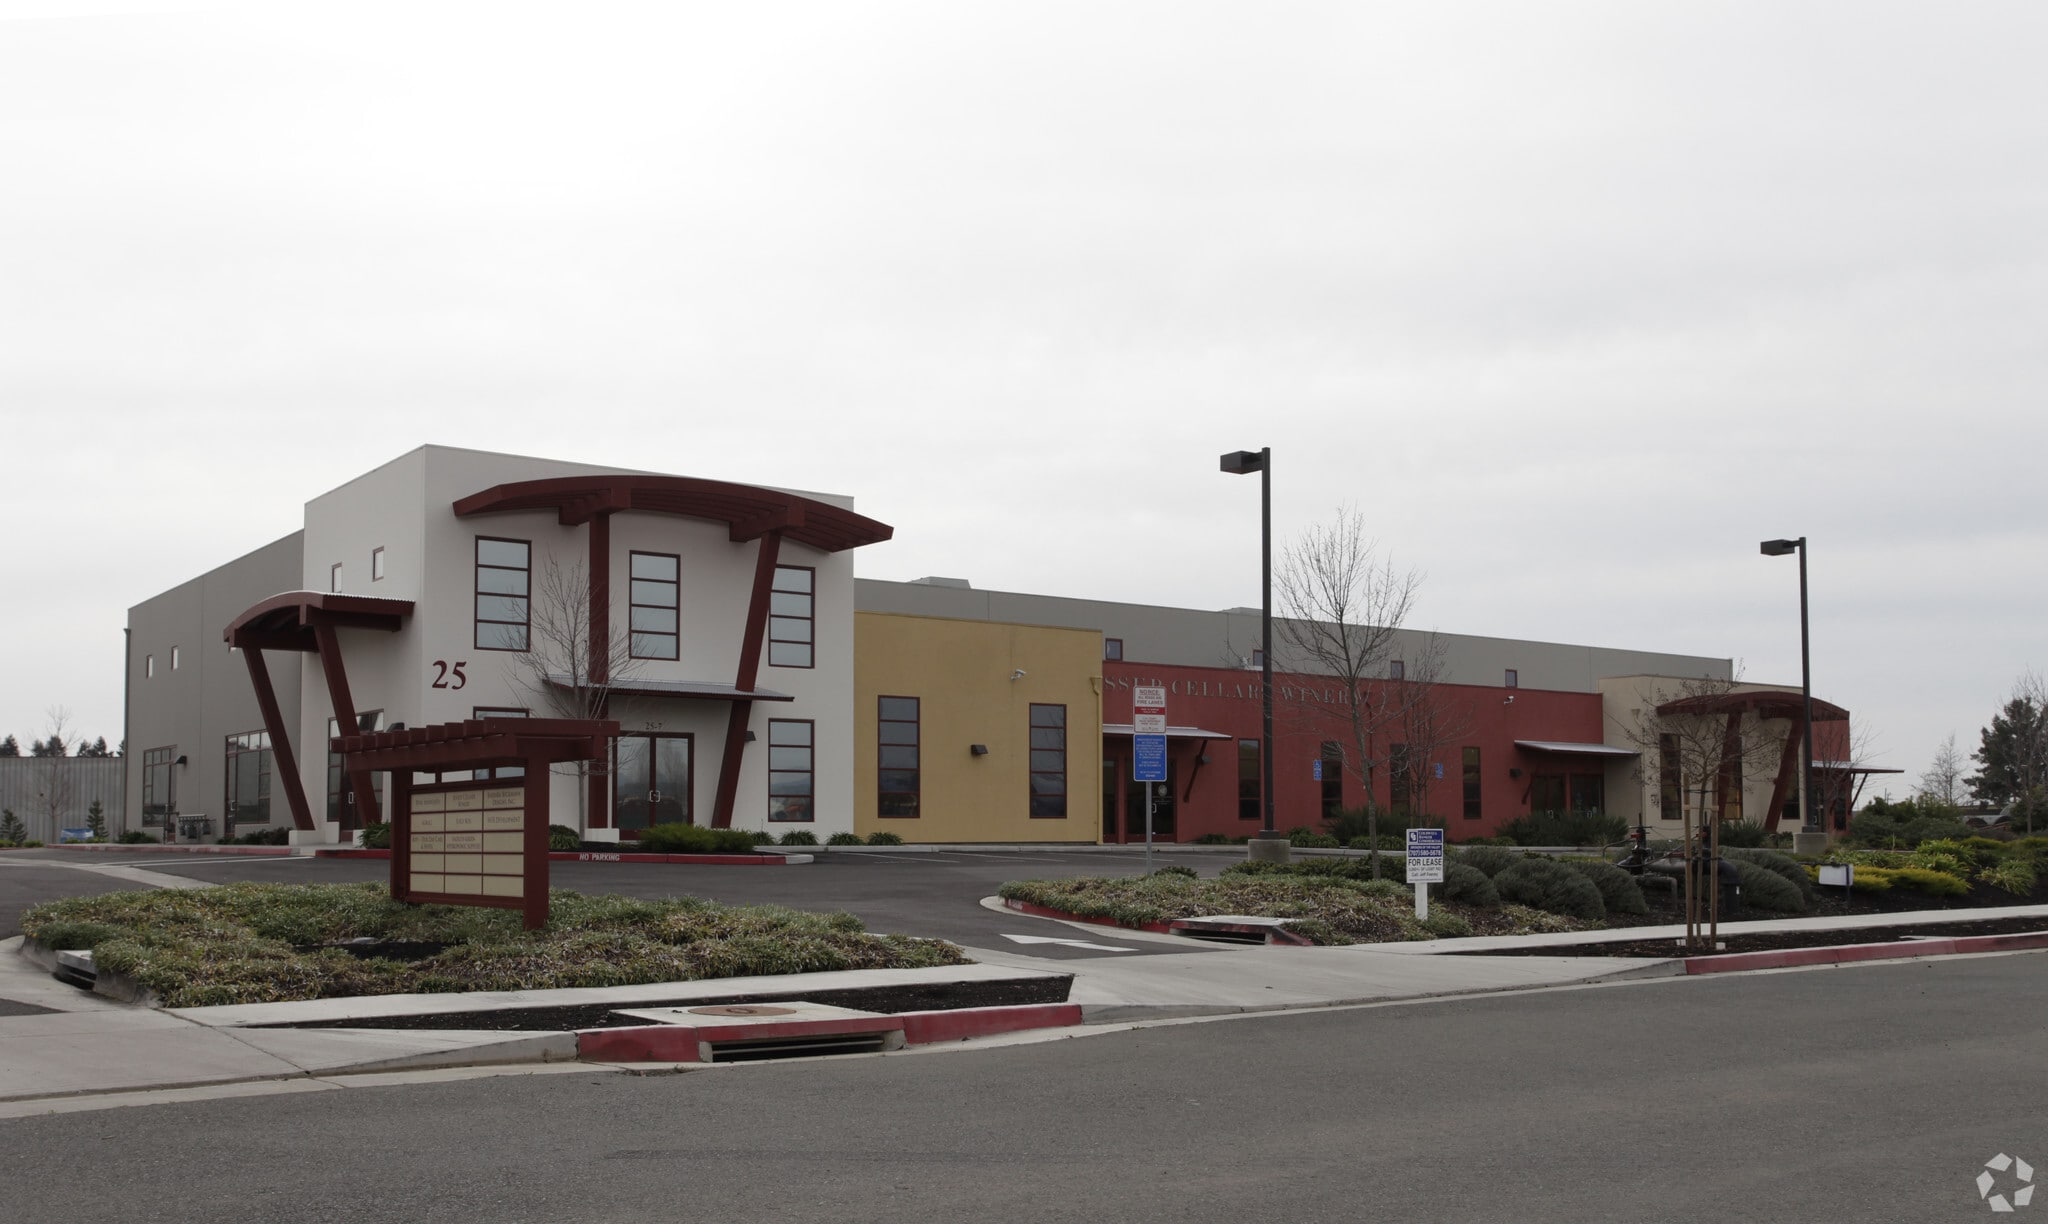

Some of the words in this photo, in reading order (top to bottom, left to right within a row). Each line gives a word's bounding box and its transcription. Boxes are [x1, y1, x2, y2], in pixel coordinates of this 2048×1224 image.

[432, 660, 467, 690] 25
[1171, 680, 1264, 700] CELLAR
[579, 853, 590, 861] NO
[592, 853, 620, 862] PARKING
[1408, 858, 1421, 866] FOR
[1422, 858, 1442, 866] LEASE
